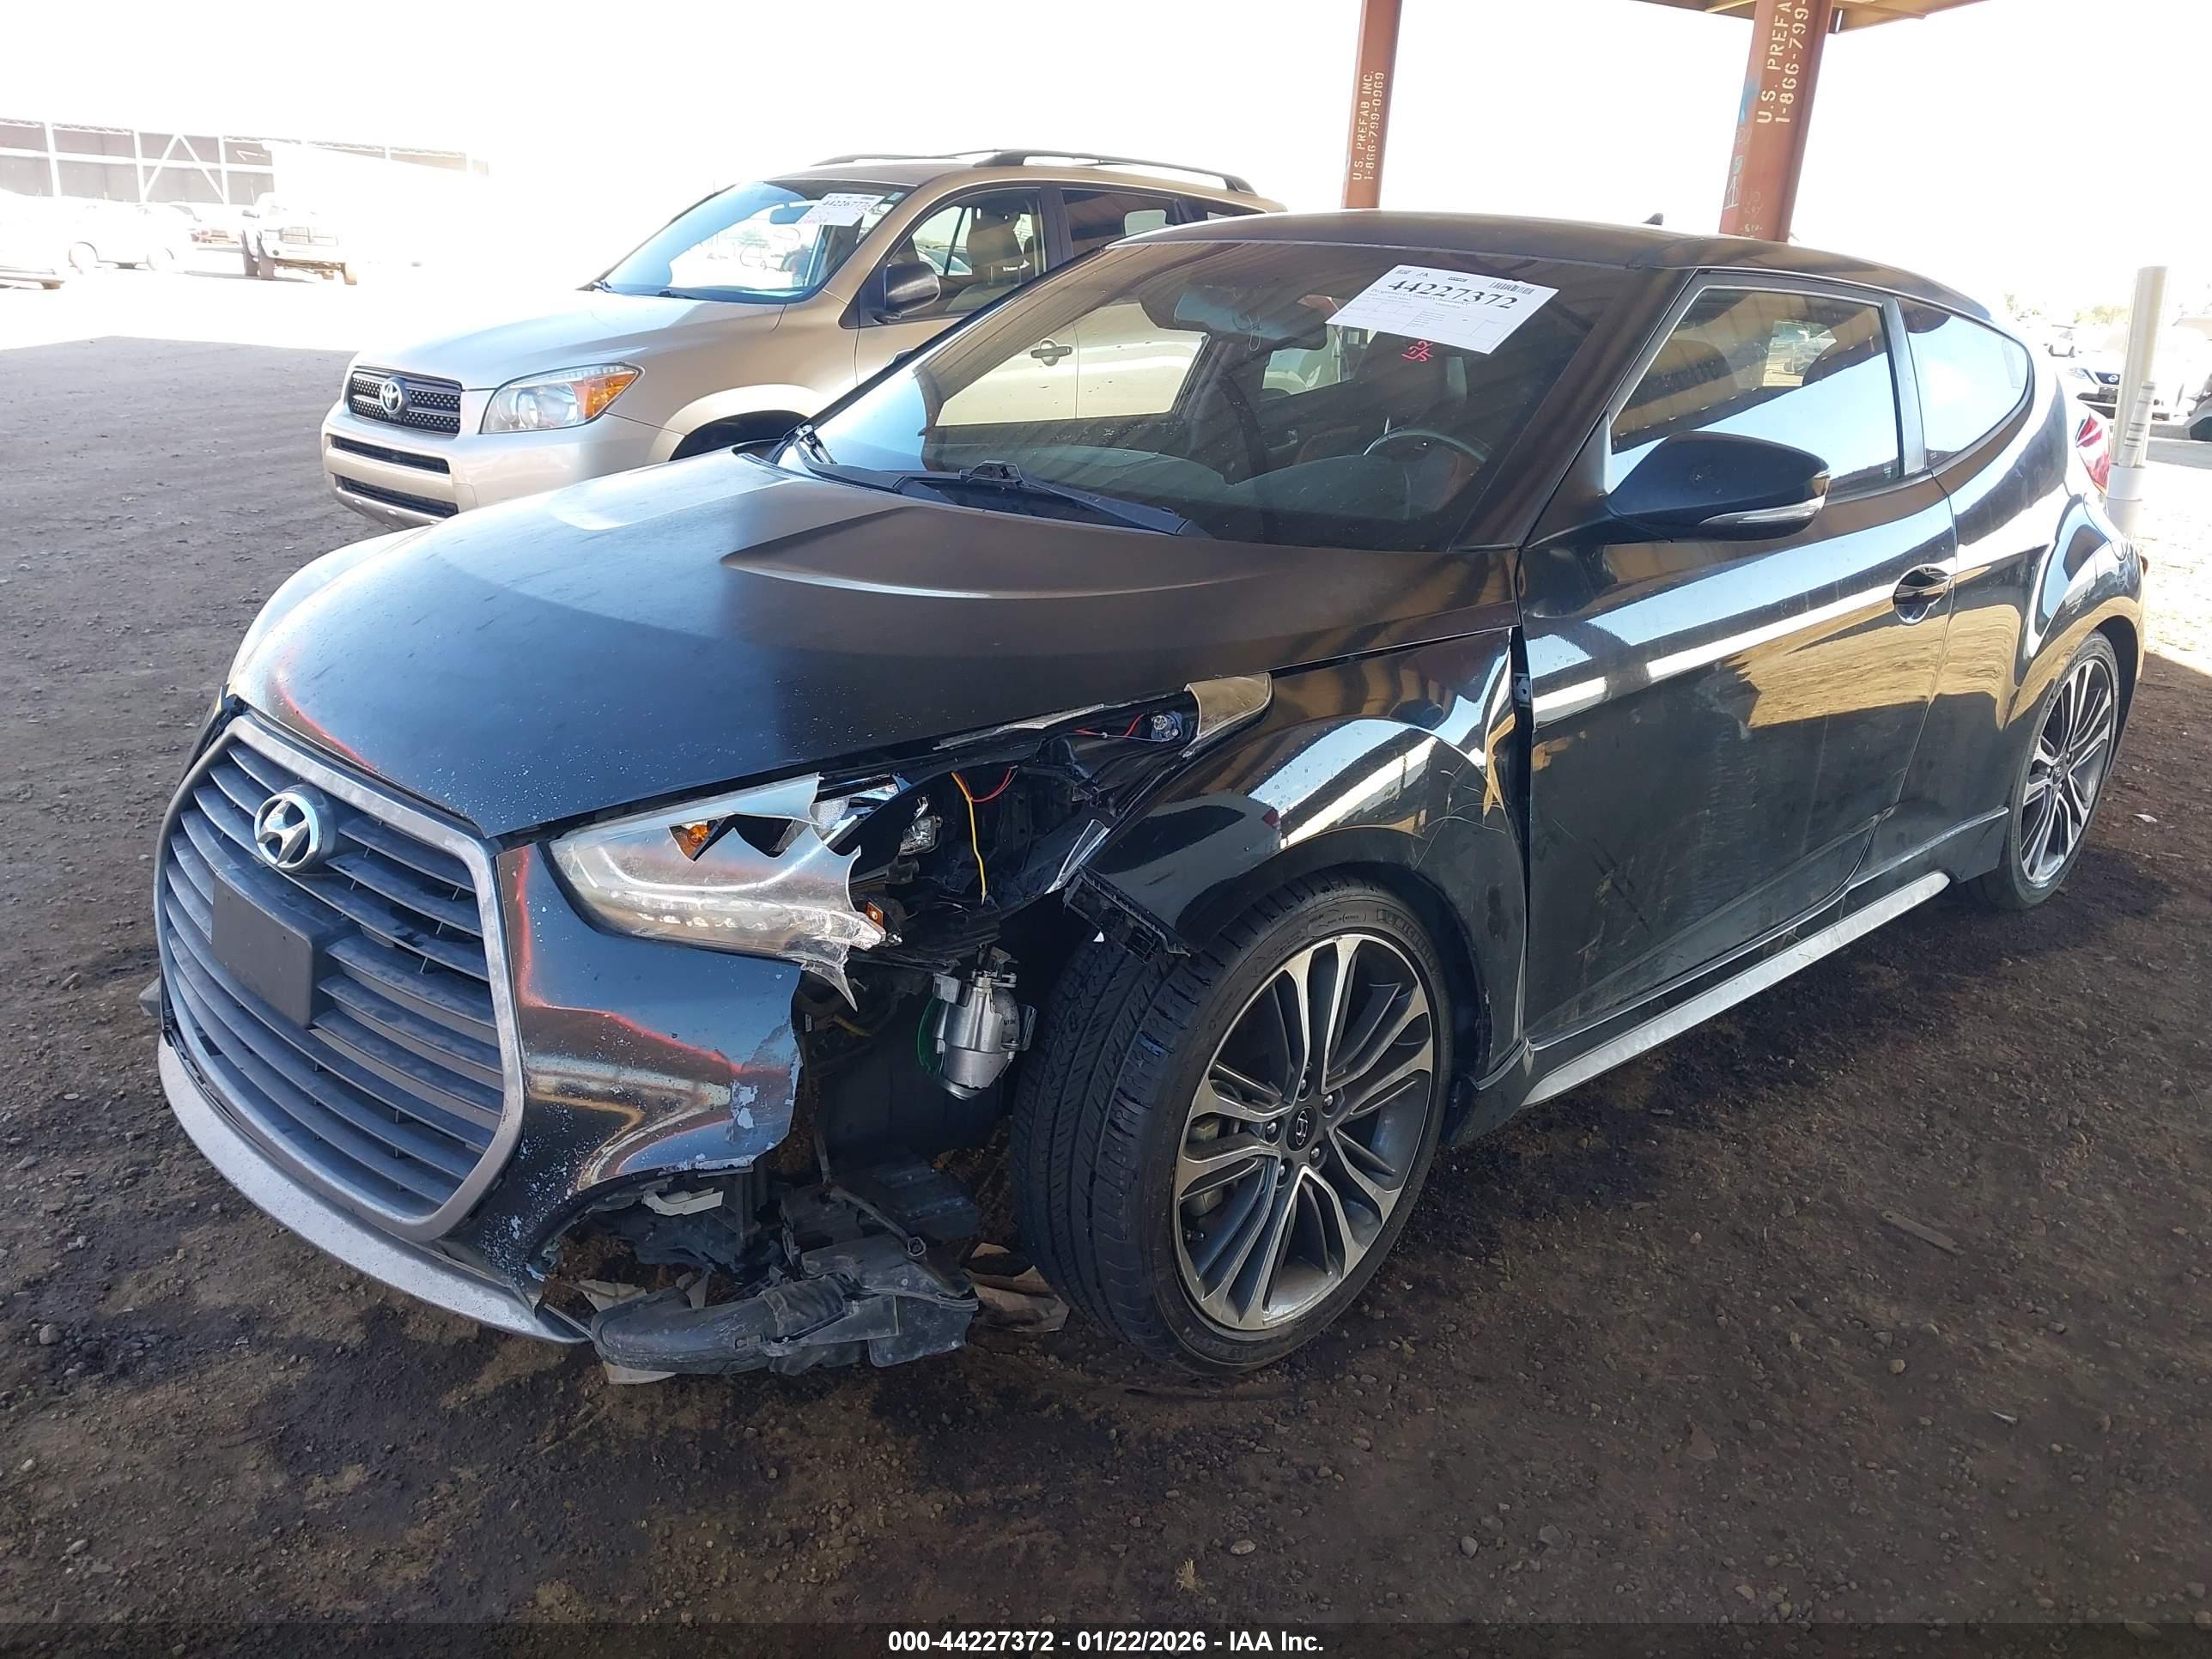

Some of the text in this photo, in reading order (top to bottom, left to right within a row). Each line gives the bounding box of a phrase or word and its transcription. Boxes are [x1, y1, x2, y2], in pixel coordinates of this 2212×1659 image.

[1352, 70, 1374, 180] U.S. PREFAB INC.
[1364, 72, 1384, 179] 1-866-799-0969
[1756, 84, 1778, 123] U.S.
[1388, 280, 1518, 309] 44227372
